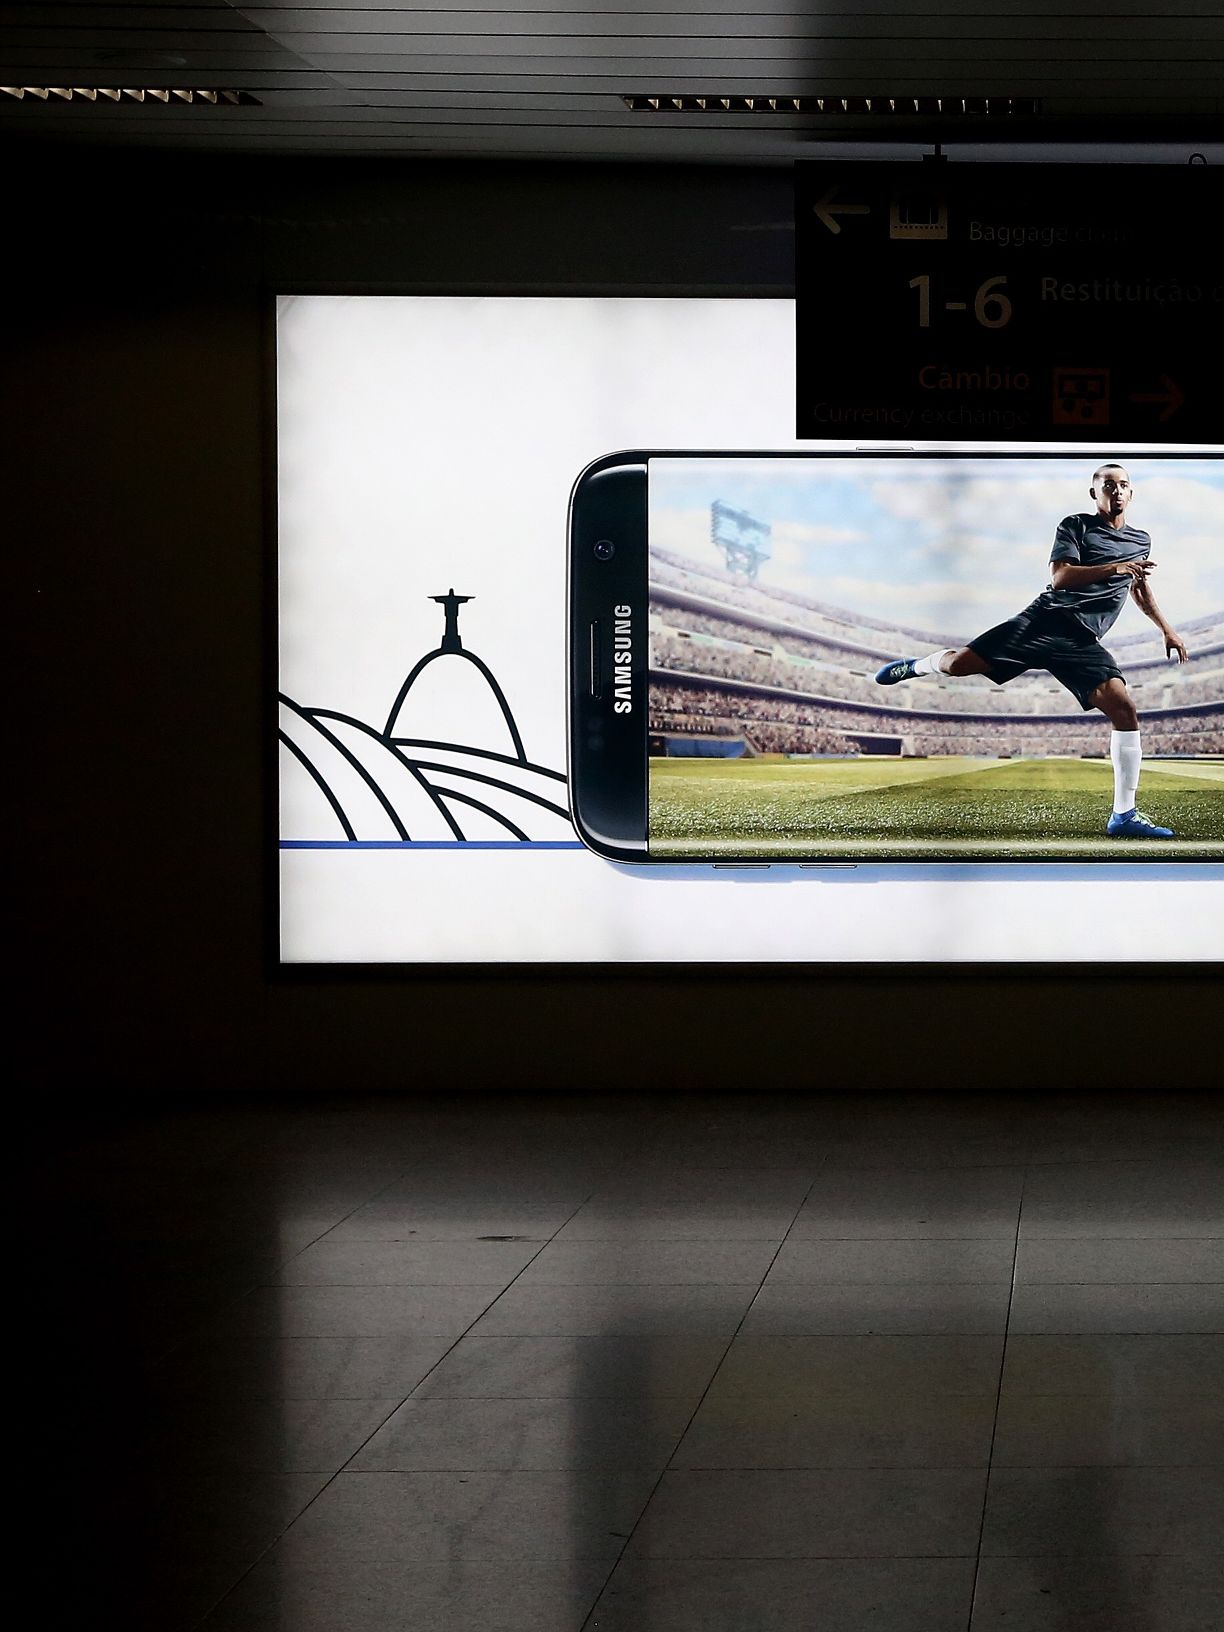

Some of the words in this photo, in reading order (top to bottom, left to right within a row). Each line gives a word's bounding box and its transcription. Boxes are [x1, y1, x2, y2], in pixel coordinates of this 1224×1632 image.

[968, 220, 1068, 248] Baggage
[908, 274, 1015, 329] 1-6
[1040, 276, 1203, 307] Restituição
[812, 402, 914, 431] Currency
[921, 403, 1032, 431] exchange
[614, 604, 632, 714] SAMSUNG
